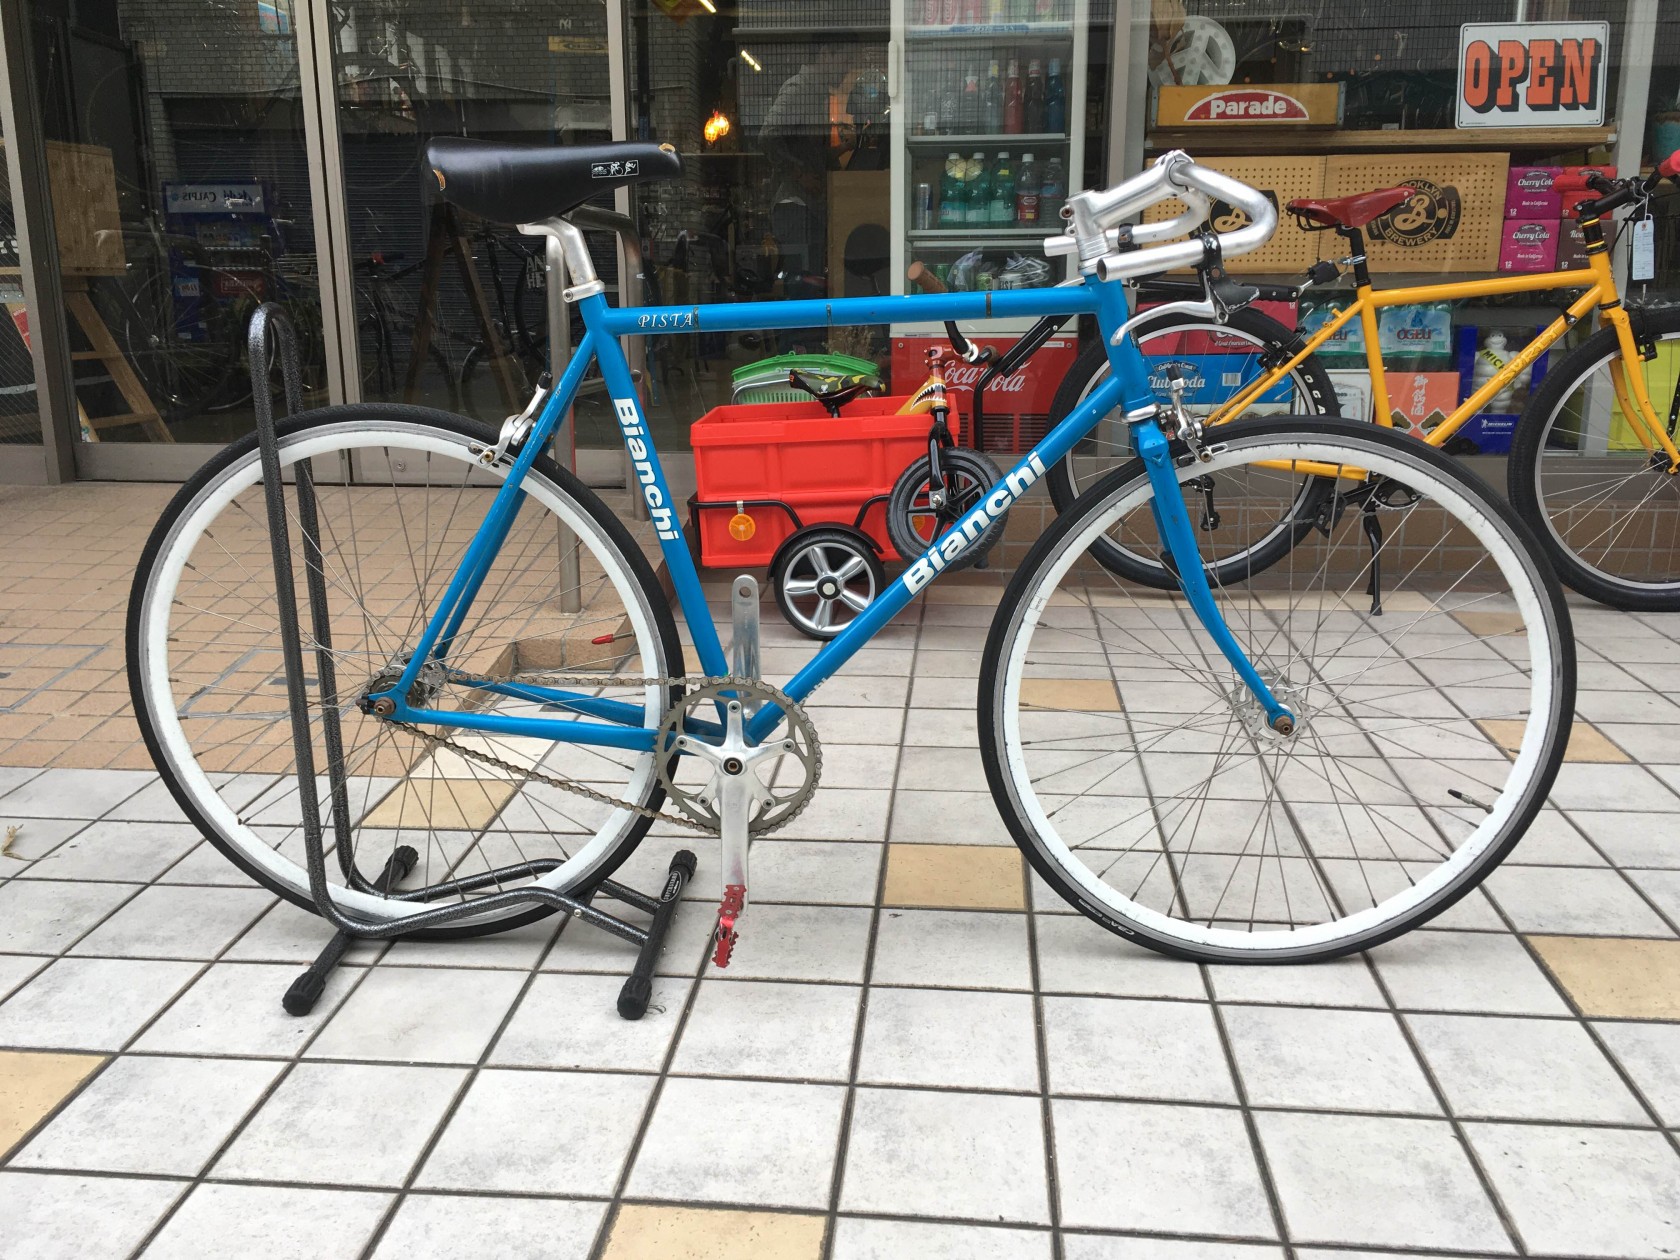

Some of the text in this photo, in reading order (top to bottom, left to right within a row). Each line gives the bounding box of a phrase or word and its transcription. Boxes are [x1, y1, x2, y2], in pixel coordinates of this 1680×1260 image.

[1464, 38, 1601, 113] OPEN
[1210, 95, 1287, 118] Parade
[1401, 180, 1442, 200] OKLYN
[1518, 178, 1539, 187] Cherry
[1385, 228, 1438, 247] BREWERY
[1513, 231, 1550, 240] Cherry Cola
[1570, 229, 1585, 238] Roo
[638, 313, 693, 328] PISTA
[1396, 328, 1432, 340] OGEU
[1184, 375, 1206, 388] oda
[613, 398, 680, 541] Bianchi
[902, 450, 1046, 596] Bianchi
